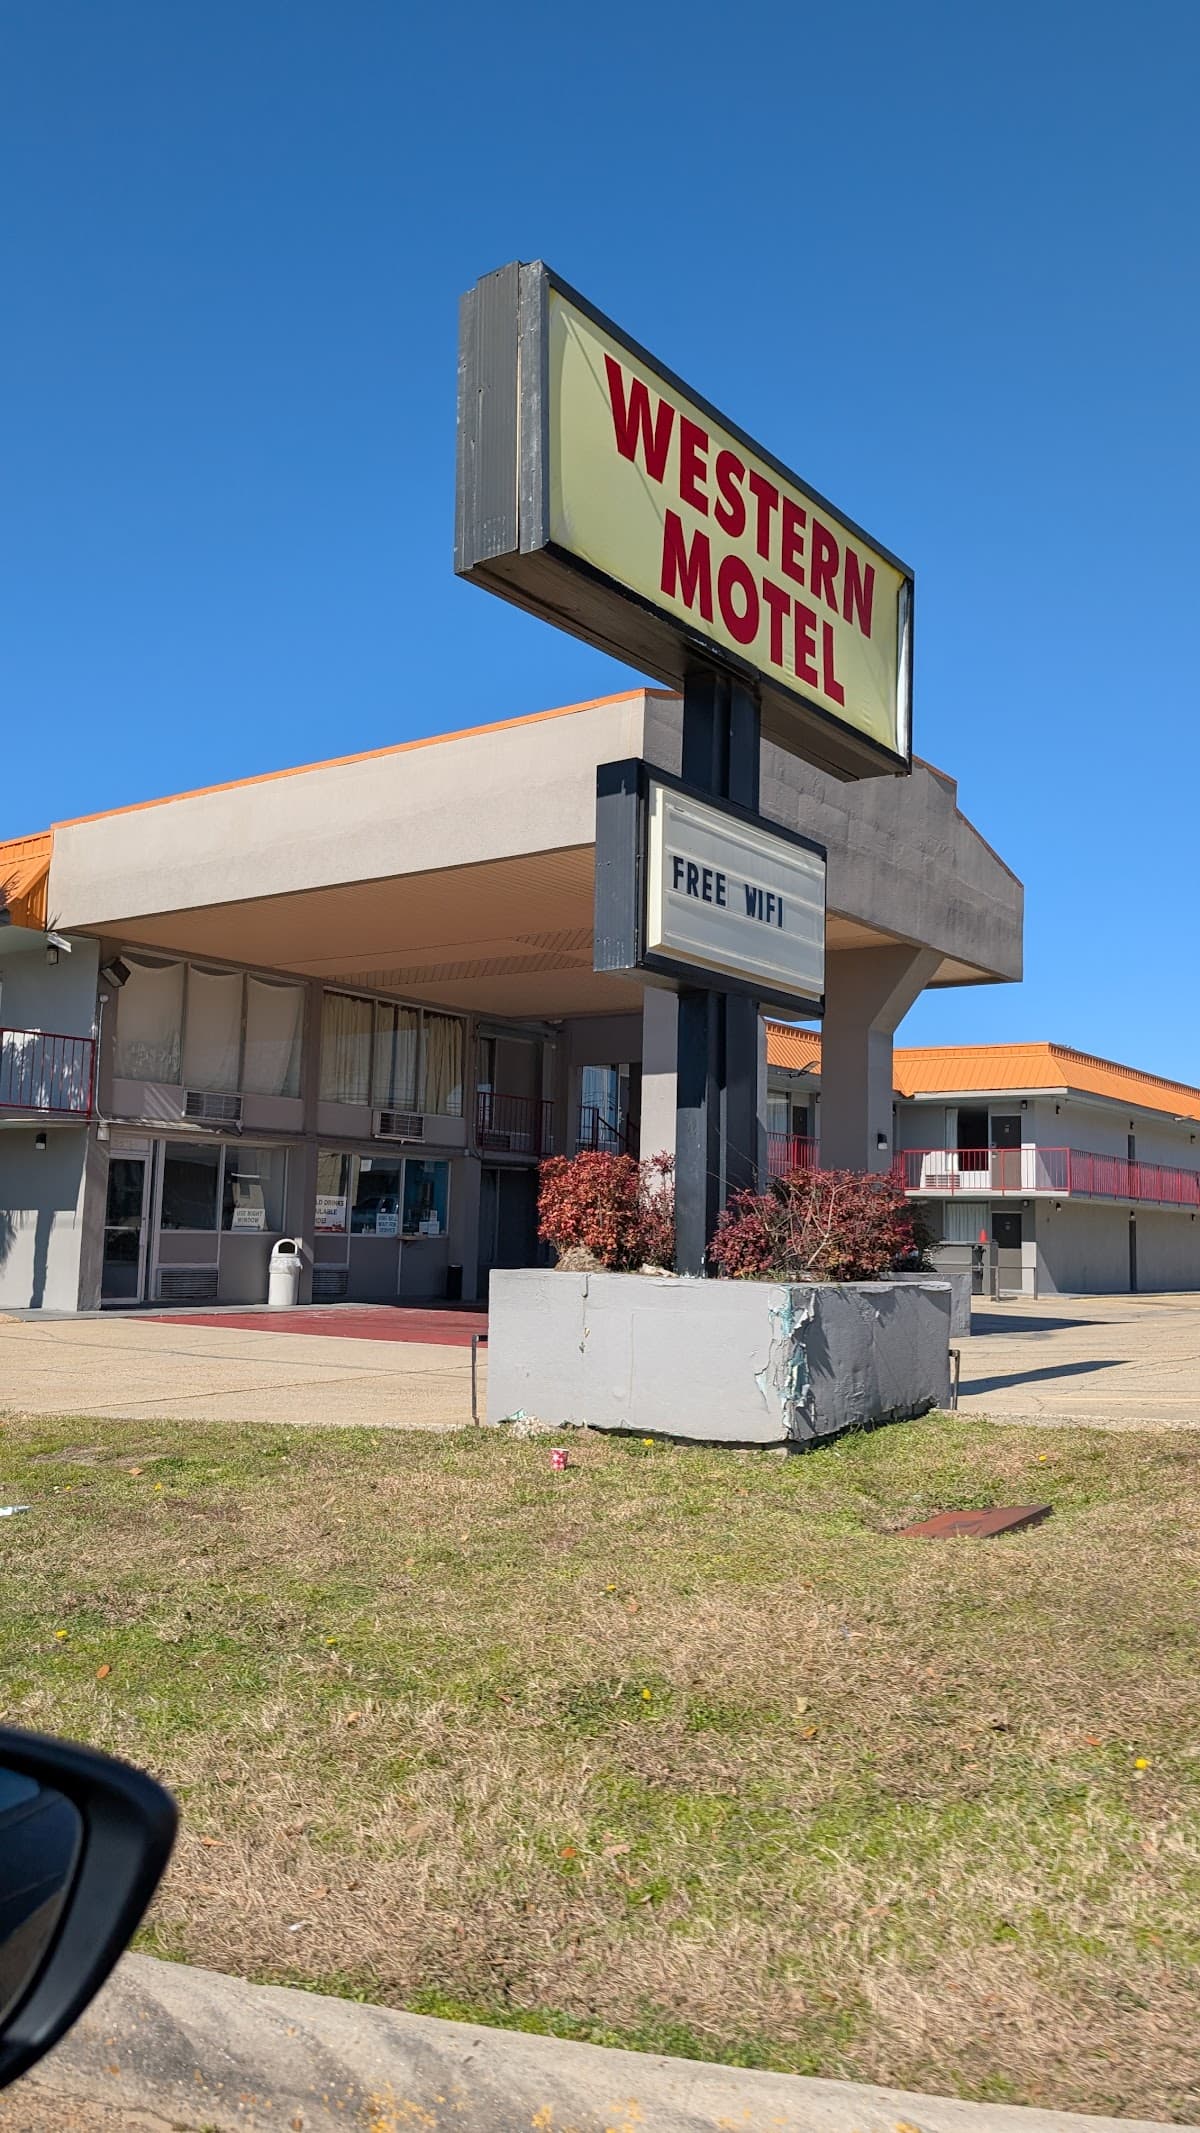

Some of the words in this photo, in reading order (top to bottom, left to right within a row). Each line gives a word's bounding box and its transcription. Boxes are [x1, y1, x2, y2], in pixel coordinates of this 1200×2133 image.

[604, 355, 874, 637] WESTERN
[660, 509, 844, 706] MOTEL
[672, 855, 727, 908] FREE
[743, 883, 784, 929] WIFI
